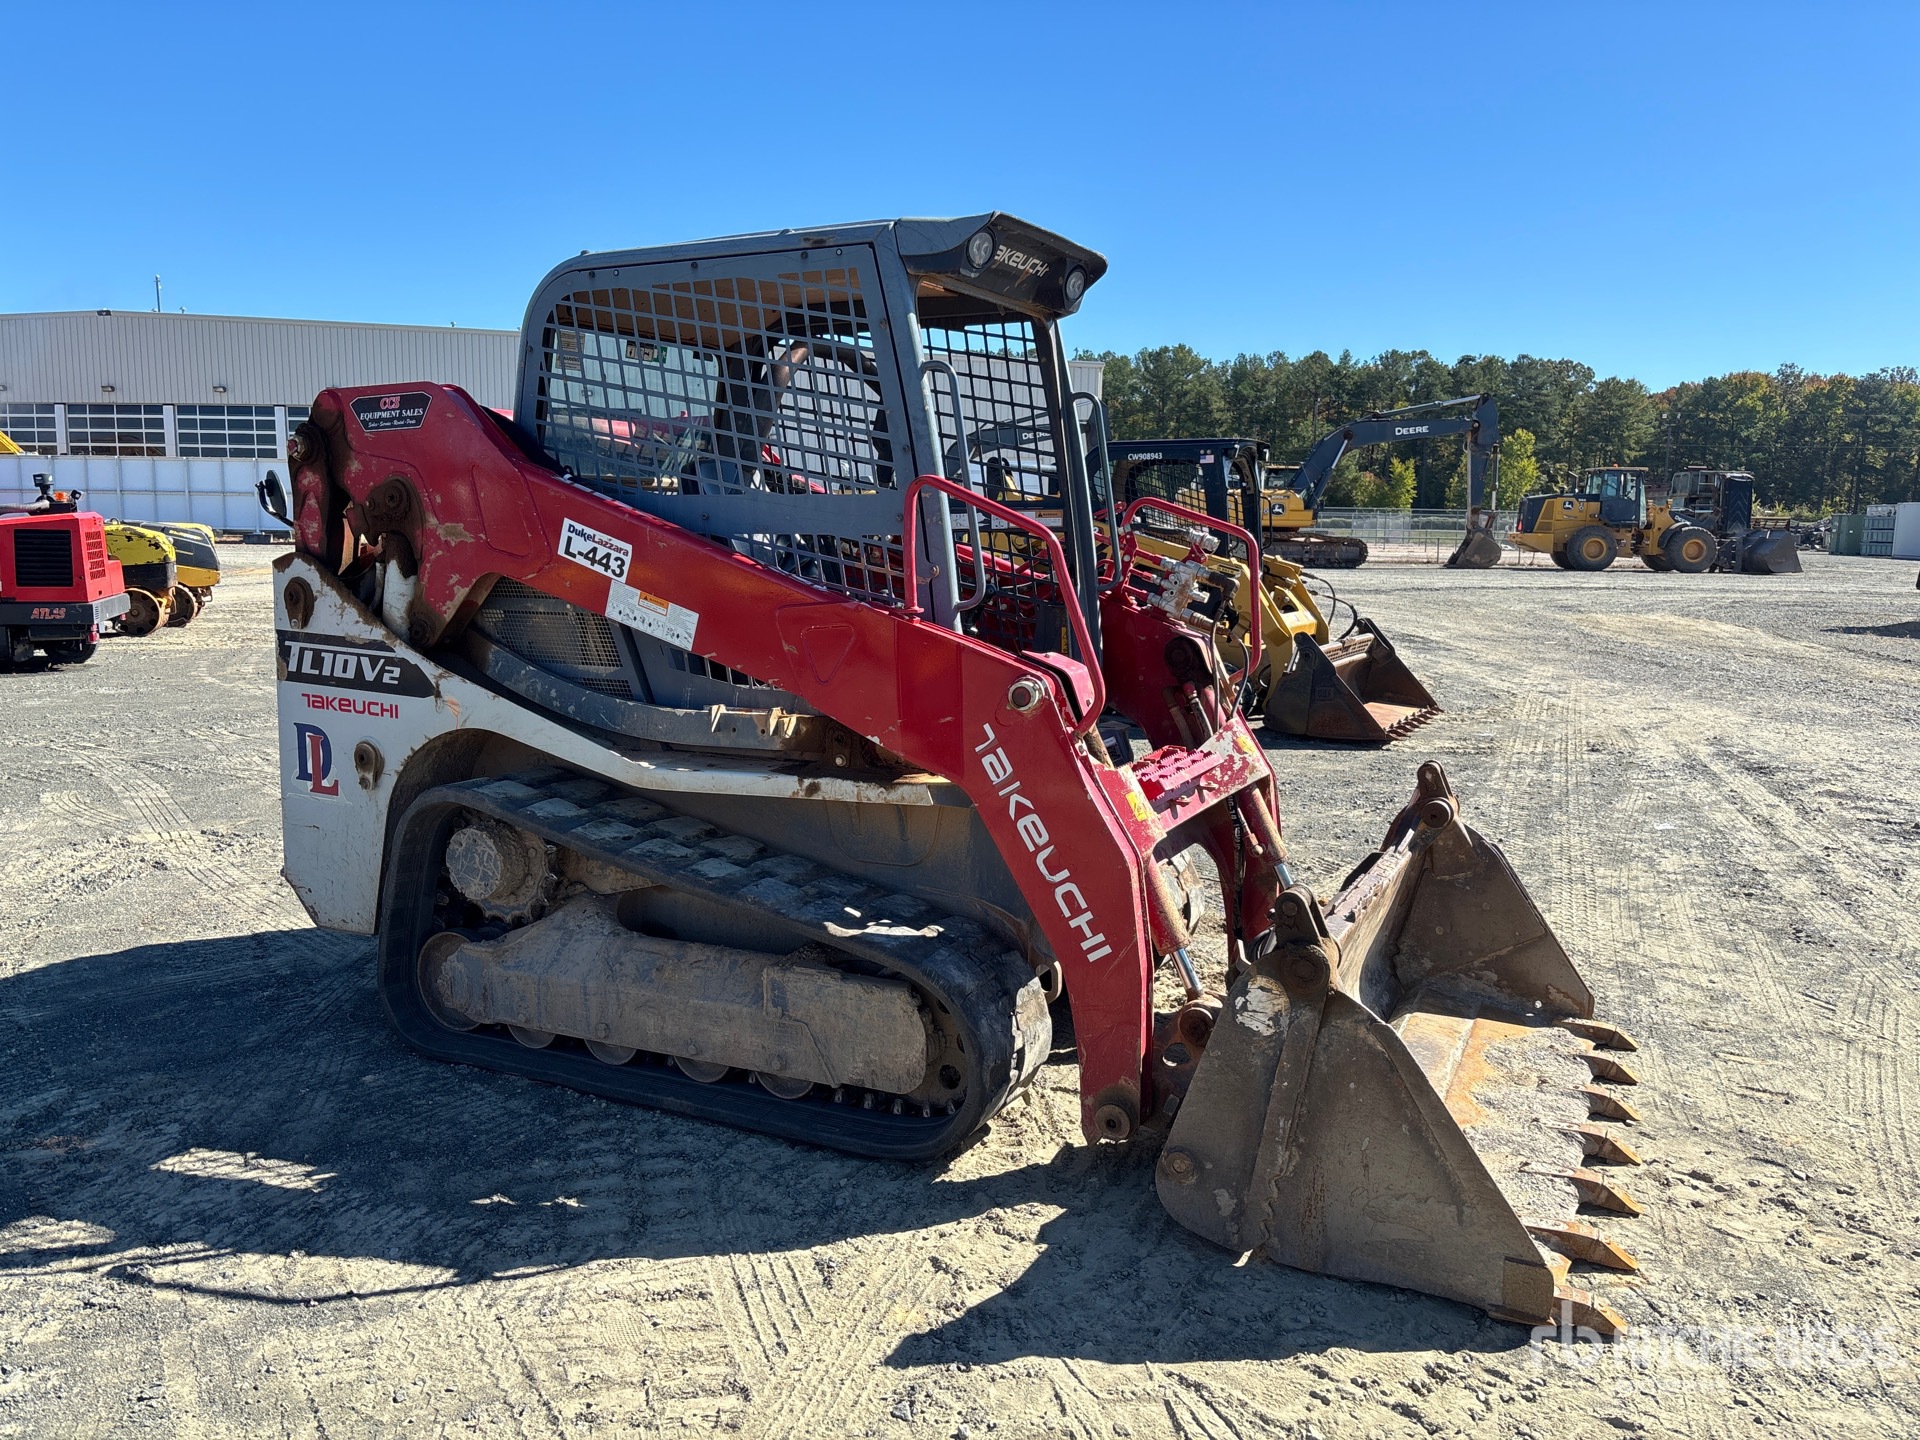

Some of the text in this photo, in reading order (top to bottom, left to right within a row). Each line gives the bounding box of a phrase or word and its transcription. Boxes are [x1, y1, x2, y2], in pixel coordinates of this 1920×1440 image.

[994, 244, 1050, 278] AKEUCHI
[380, 396, 401, 410] CCS
[360, 408, 423, 421] EQUIPMENT SALES
[1395, 425, 1429, 436] DEERE
[1127, 452, 1163, 461] CW908943
[567, 523, 629, 557] DukeLazzara
[564, 536, 626, 578] L-443
[31, 607, 66, 620] ATLAS
[285, 641, 401, 684] TL10V2
